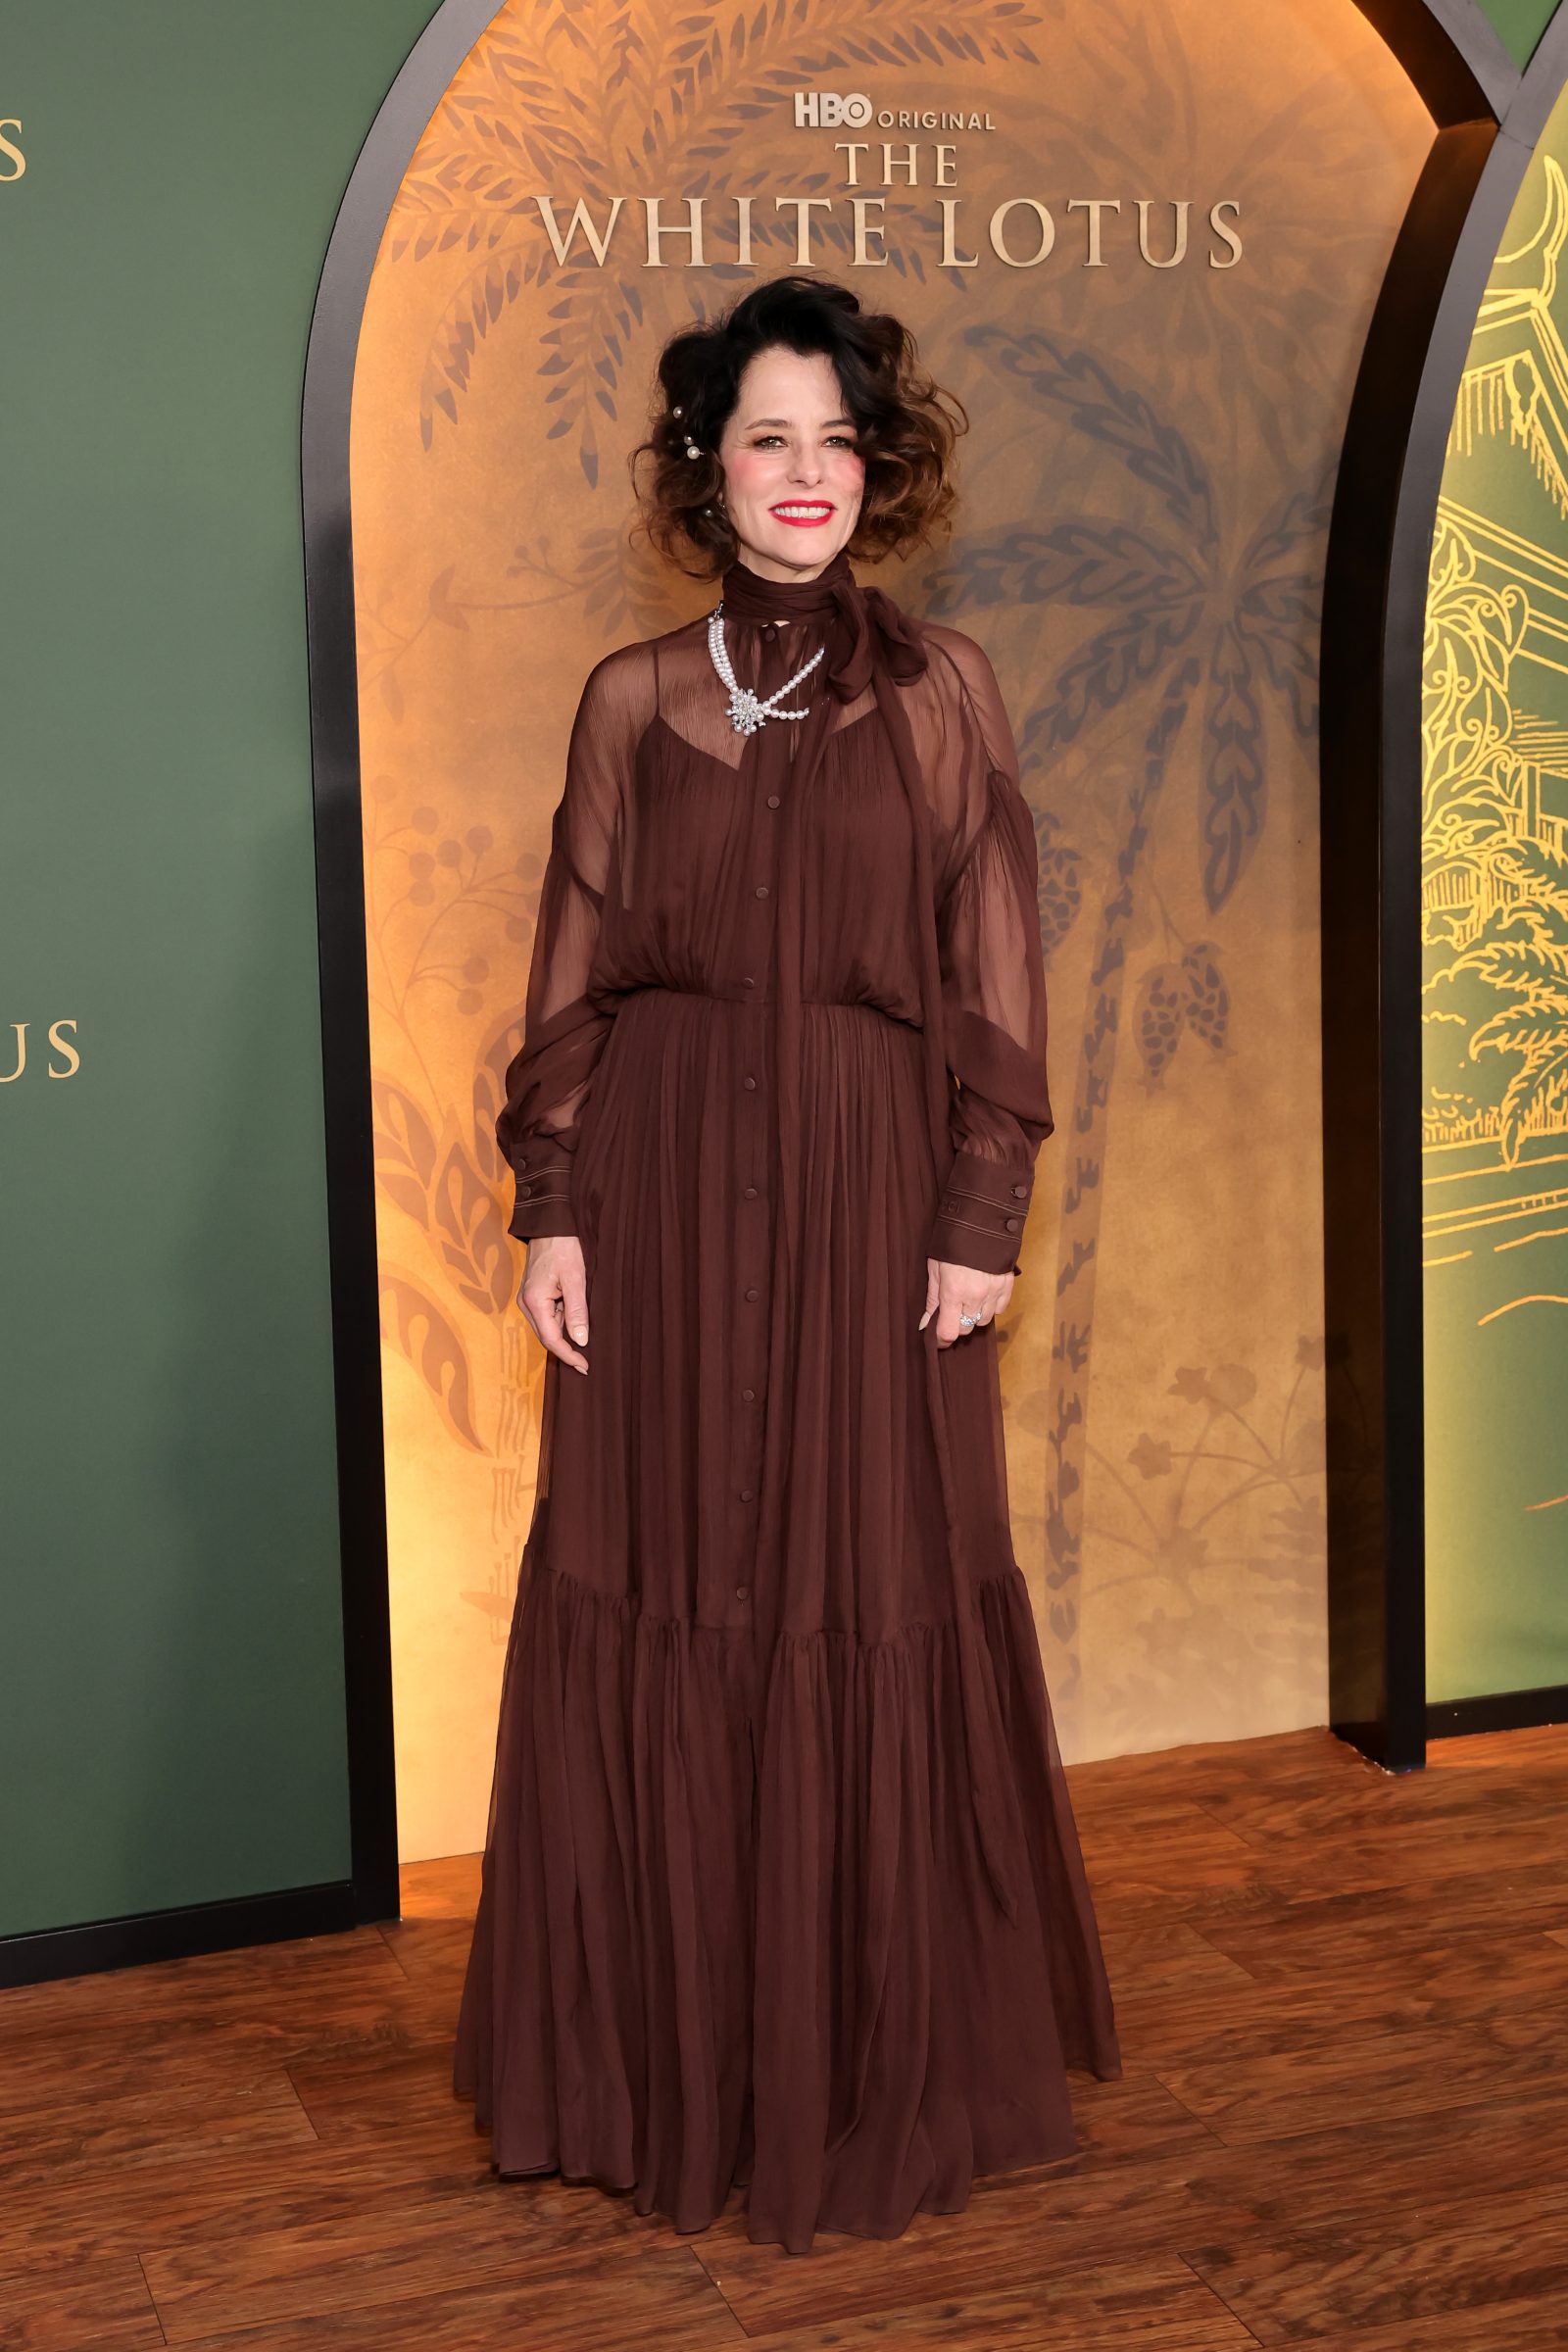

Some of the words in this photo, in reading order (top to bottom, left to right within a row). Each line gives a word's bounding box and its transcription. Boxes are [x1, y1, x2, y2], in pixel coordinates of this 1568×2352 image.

[795, 92, 873, 128] HBO
[877, 110, 997, 130] ORIGINAL
[834, 143, 958, 187] THE
[530, 195, 889, 268] WHITE
[936, 198, 1243, 269] LOTUS
